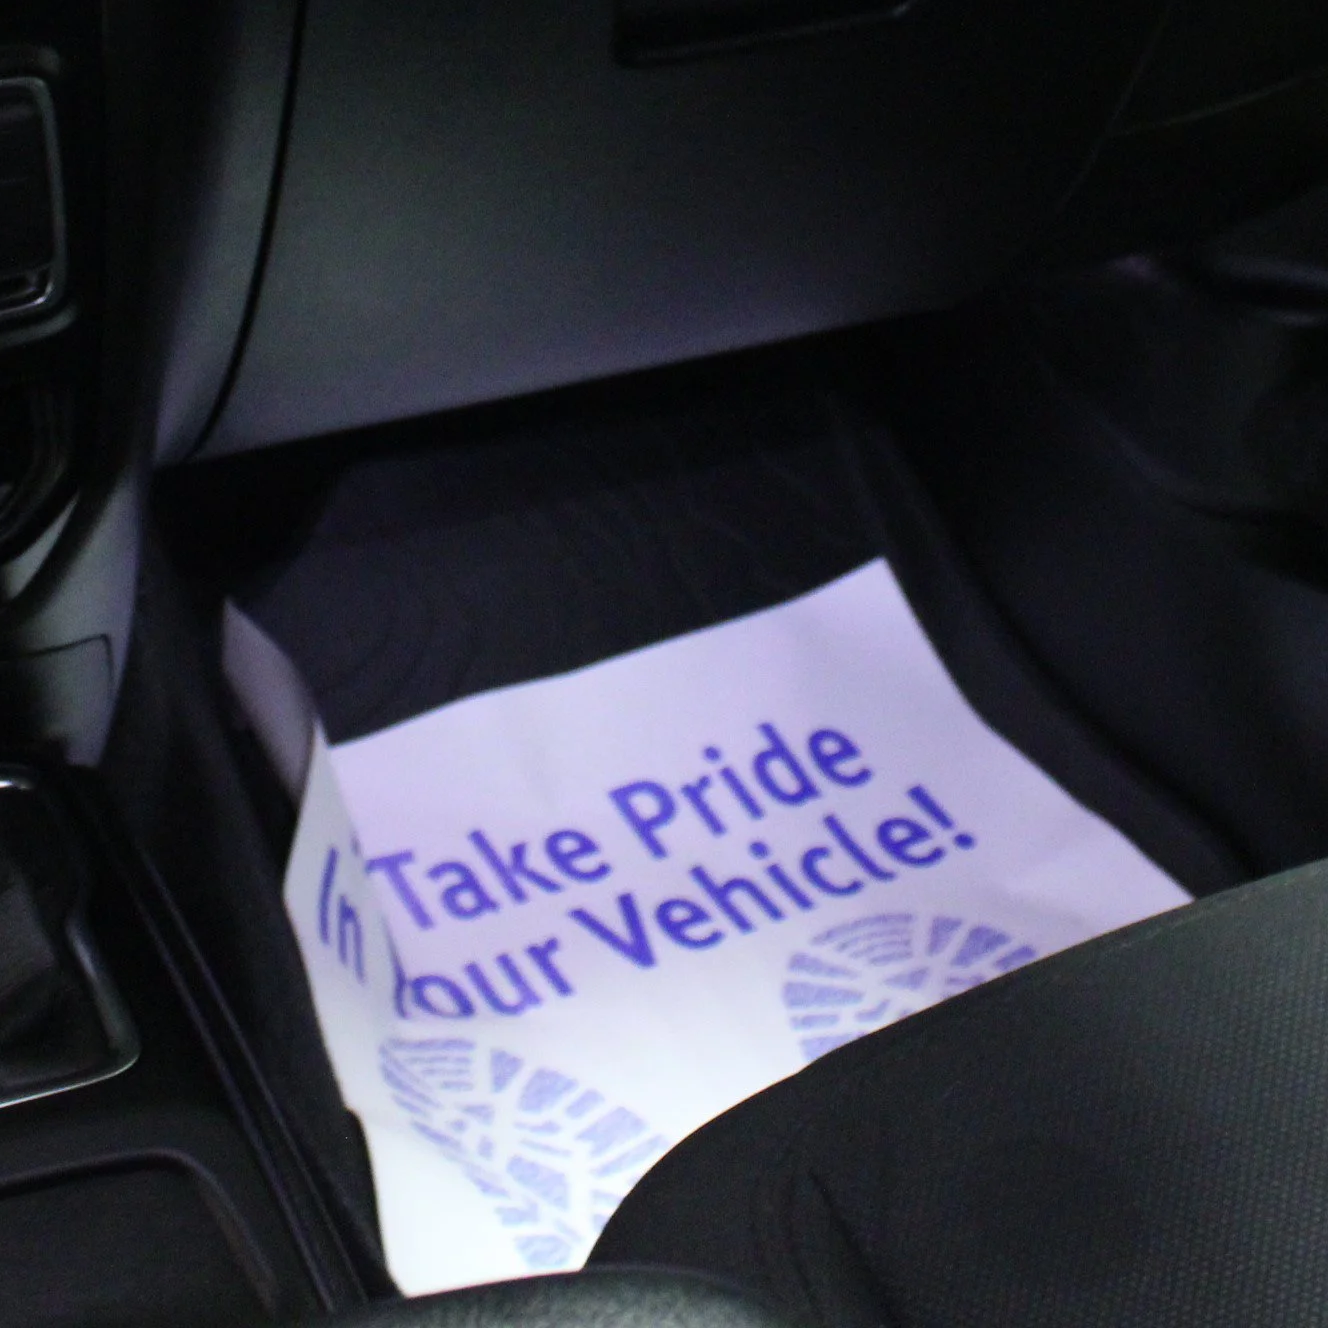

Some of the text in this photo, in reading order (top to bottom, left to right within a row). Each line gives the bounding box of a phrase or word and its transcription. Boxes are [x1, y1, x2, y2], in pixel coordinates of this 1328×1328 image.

[365, 721, 873, 931] Take Pride
[568, 784, 977, 970] Vehicle!
